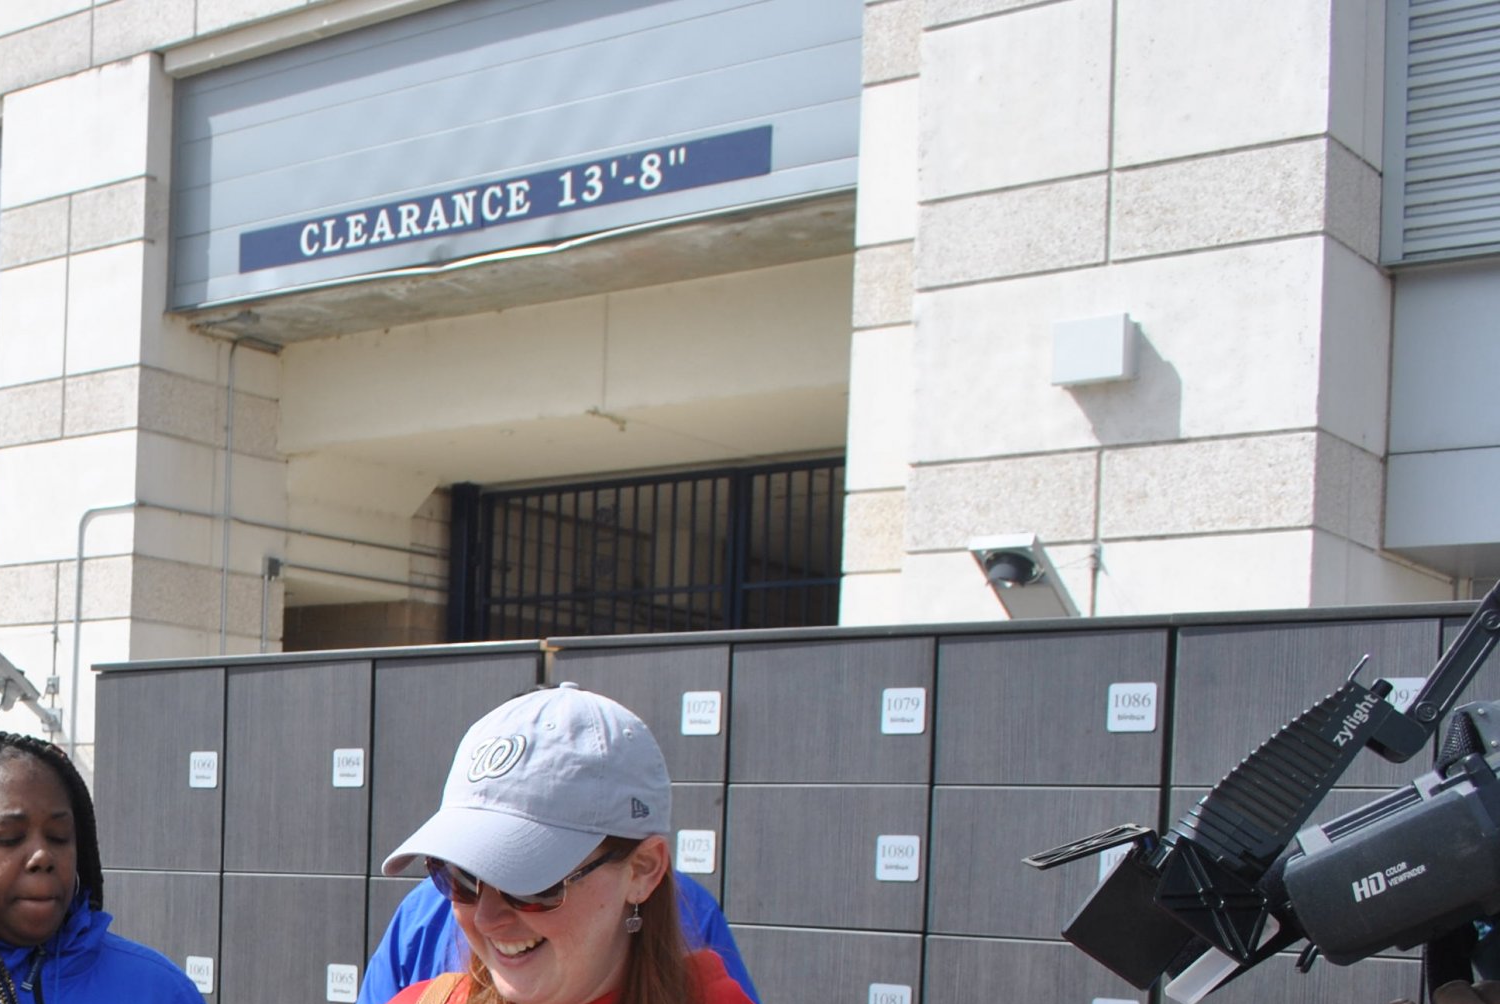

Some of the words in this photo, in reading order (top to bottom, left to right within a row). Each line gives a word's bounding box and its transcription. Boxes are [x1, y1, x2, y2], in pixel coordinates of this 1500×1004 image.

[300, 180, 531, 256] CLEARANCE
[558, 146, 687, 207] 13'-8"
[686, 700, 716, 714] 1072
[887, 697, 920, 711] 1079
[1114, 693, 1151, 708] 1086
[1332, 694, 1379, 747] zylight
[882, 844, 915, 858] 1080
[1385, 861, 1407, 877] COLOR
[1387, 864, 1426, 887] VIEWFINDER
[1352, 871, 1387, 903] HD
